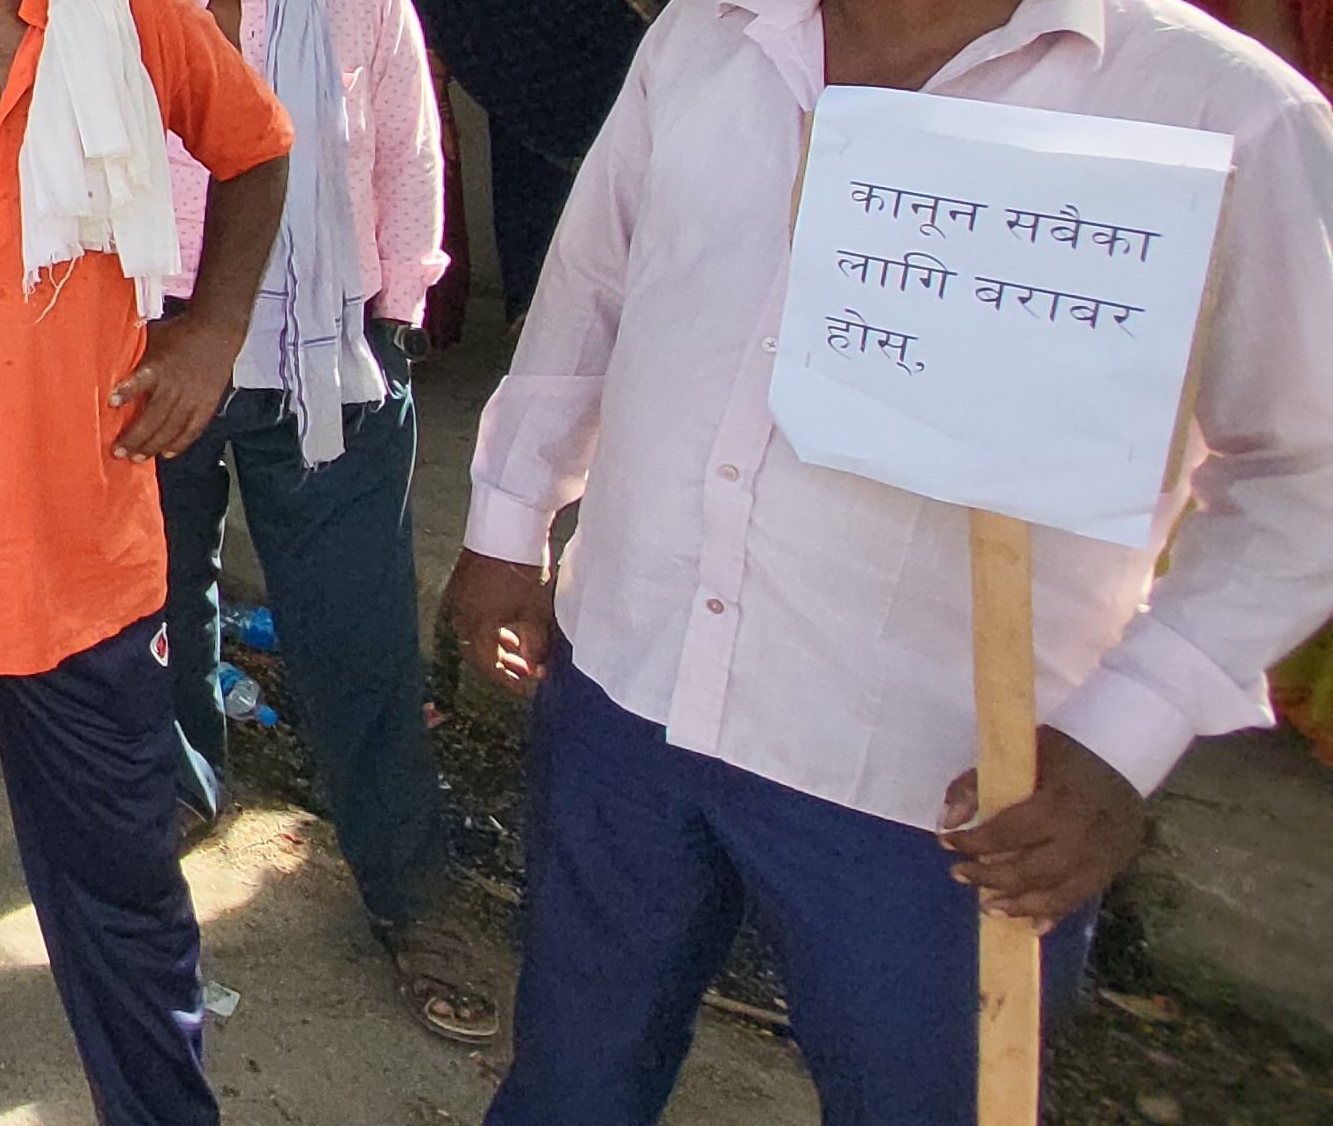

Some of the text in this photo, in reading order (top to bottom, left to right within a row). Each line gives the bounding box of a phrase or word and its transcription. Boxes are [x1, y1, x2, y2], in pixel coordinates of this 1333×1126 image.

[850, 180, 1163, 263] कानून सबैका
[836, 250, 1145, 338] लागि बराबर
